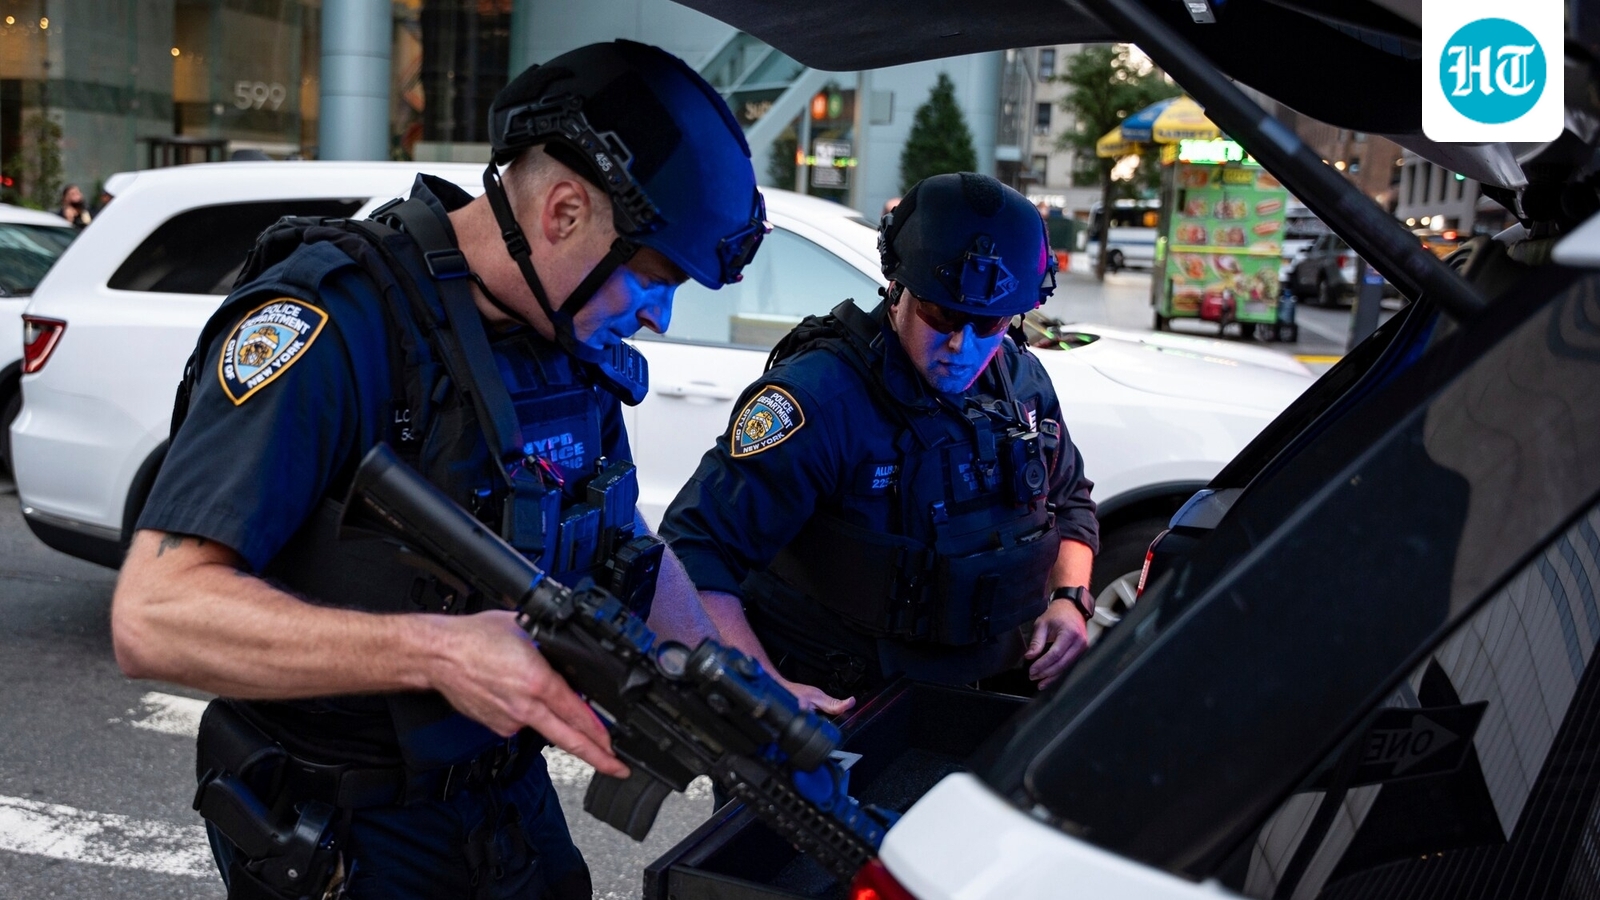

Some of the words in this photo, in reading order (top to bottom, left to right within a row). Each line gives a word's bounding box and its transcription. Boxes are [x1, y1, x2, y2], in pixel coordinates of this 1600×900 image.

[233, 80, 287, 111] 599
[595, 152, 613, 172] 455
[261, 303, 302, 317] POLICE
[240, 313, 311, 335] DEPARTMENT
[225, 339, 236, 363] CITY
[224, 364, 236, 380] OF
[246, 366, 273, 389] NEW
[271, 340, 305, 368] YORK
[756, 395, 794, 429] DEPARTMENT
[770, 392, 794, 415] POLICE
[738, 408, 751, 428] CITY
[523, 432, 574, 455] NYPD
[735, 428, 742, 441] OF
[742, 443, 760, 454] NEW
[760, 431, 785, 447] YORK
